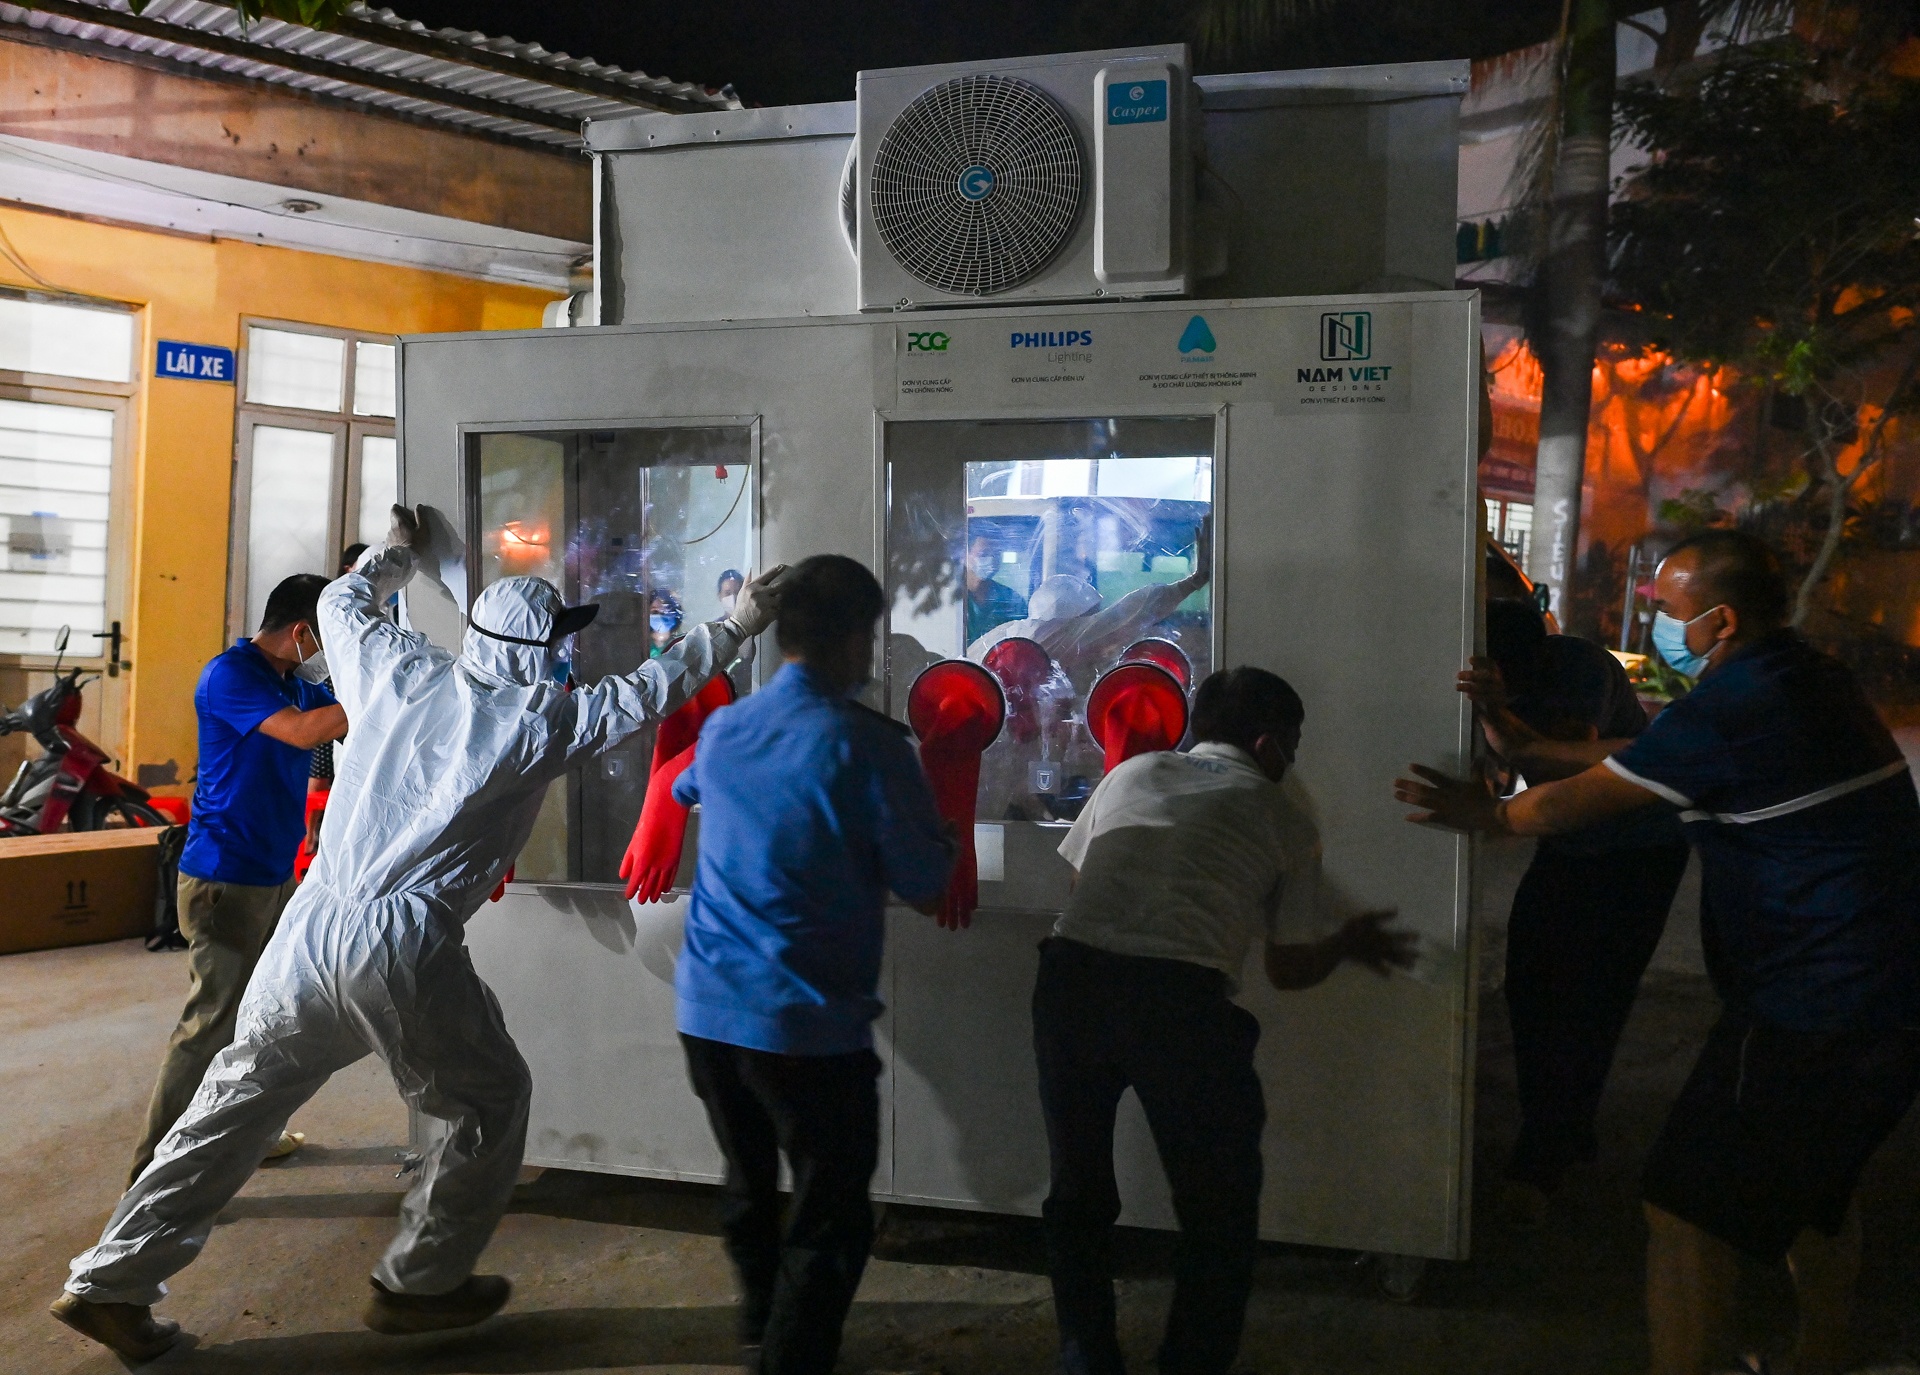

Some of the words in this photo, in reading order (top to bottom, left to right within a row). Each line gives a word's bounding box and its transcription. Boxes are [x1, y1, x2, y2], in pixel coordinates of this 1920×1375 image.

[1112, 106, 1160, 119] Casper
[1011, 330, 1092, 348] PHILIPS
[165, 348, 196, 374] LÁI
[200, 355, 224, 378] XE
[1048, 352, 1092, 364] Lighting
[1298, 368, 1342, 382] NAM
[1348, 366, 1392, 382] VIET
